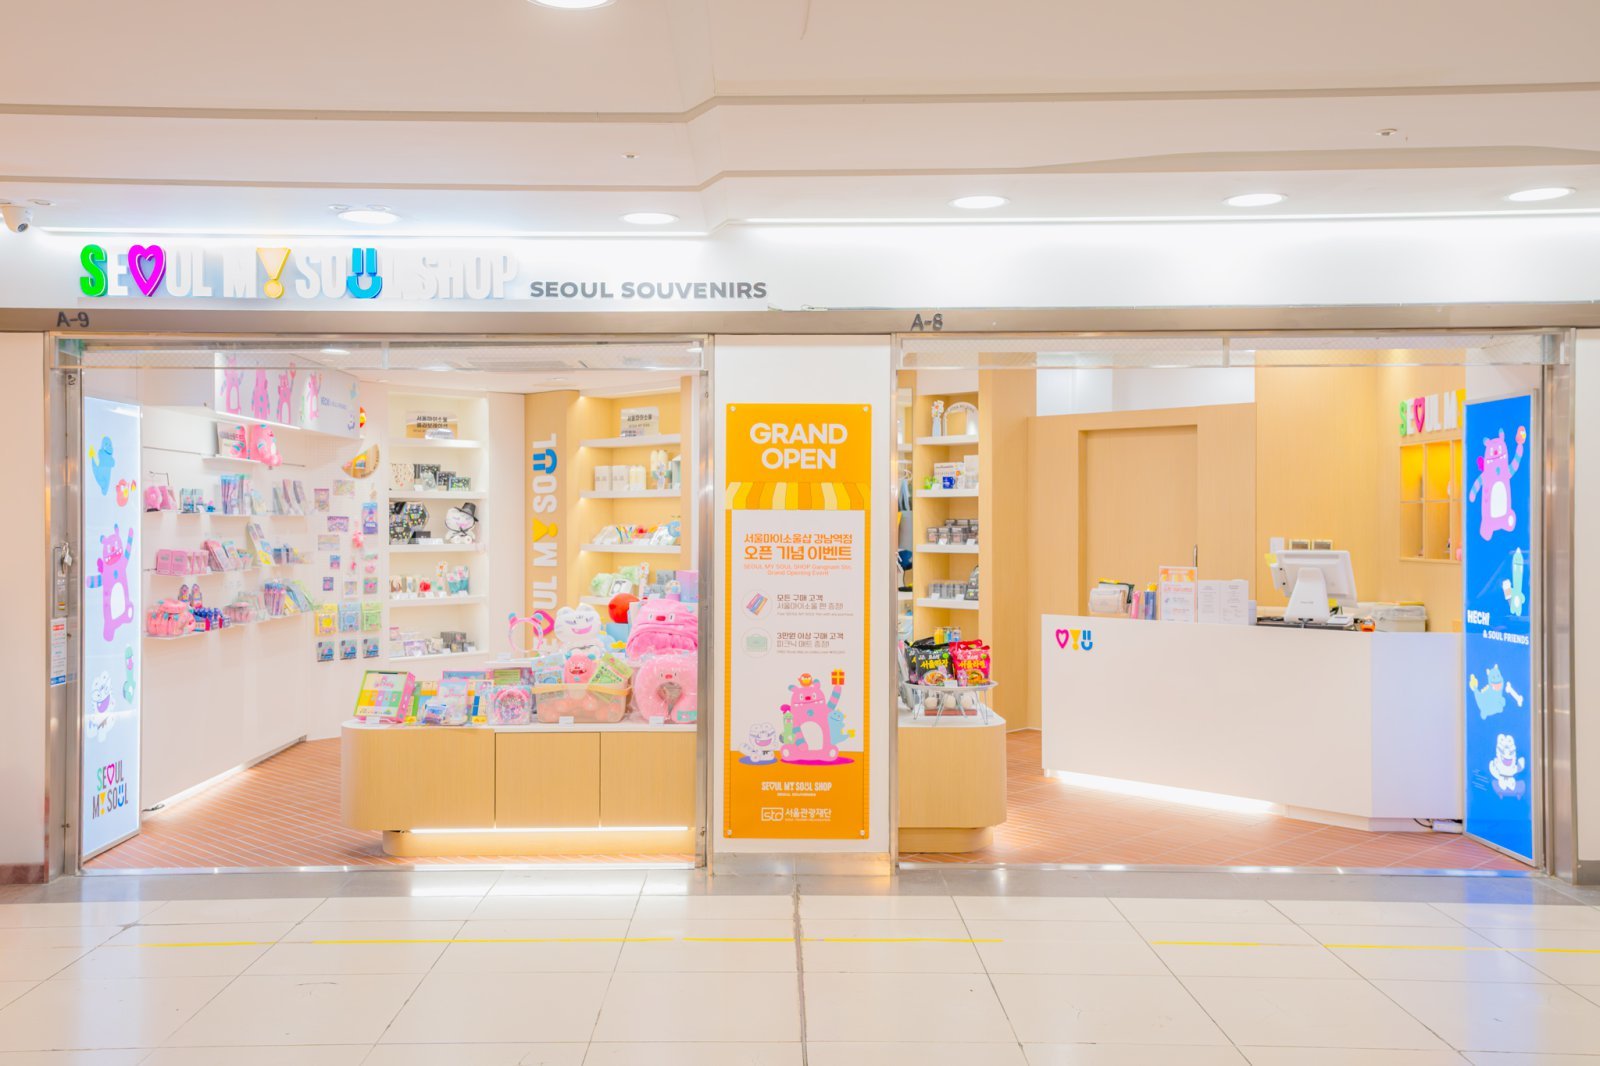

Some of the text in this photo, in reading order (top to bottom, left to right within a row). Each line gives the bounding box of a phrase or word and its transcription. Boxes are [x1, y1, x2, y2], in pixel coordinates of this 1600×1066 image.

[415, 252, 519, 300] SHOP
[529, 280, 767, 300] SEOUL SOUVENIRS
[56, 311, 90, 328] A-9
[910, 313, 944, 331] A-8
[750, 422, 848, 444] GRAND
[761, 448, 836, 469] OPEN
[744, 533, 853, 544] 서울마이소울샵 강남역점
[744, 545, 852, 560] 오픈 기념 이벤트
[1488, 630, 1503, 641] SOUL
[1504, 632, 1529, 645] FRIENDS
